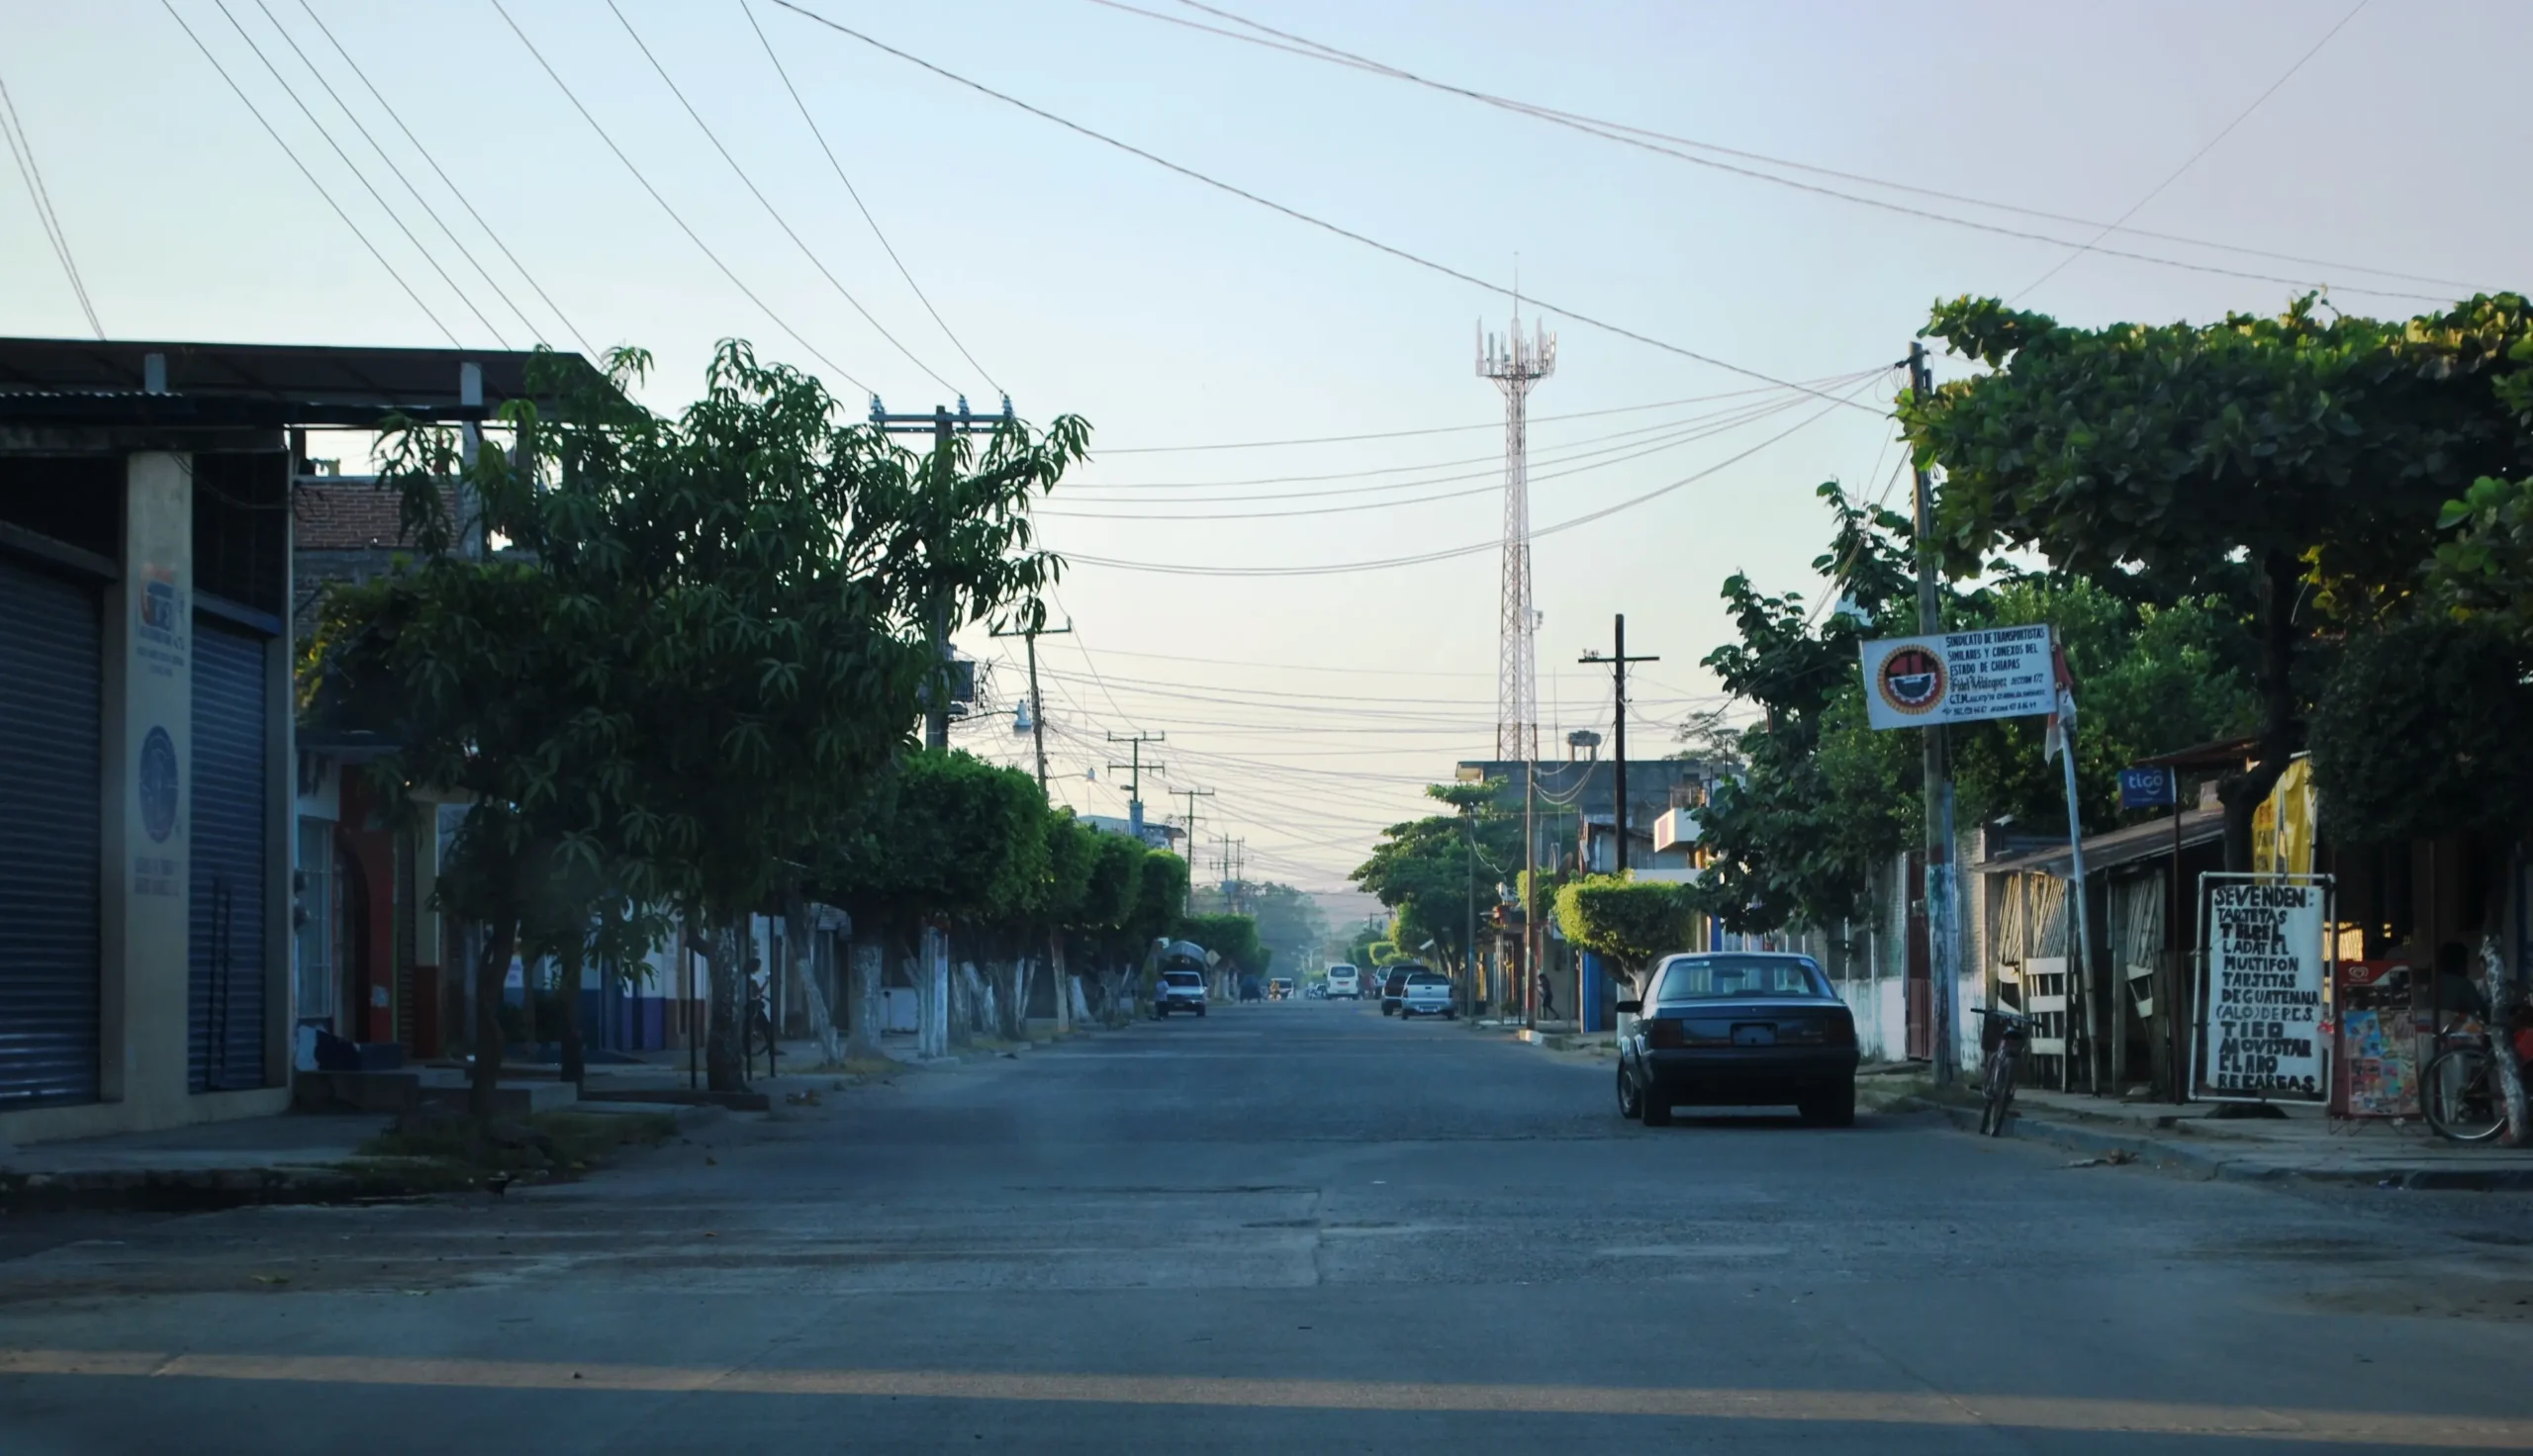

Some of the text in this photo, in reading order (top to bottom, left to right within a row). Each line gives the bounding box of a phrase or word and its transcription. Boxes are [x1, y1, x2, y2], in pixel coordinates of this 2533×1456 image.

[1945, 627, 2045, 648] SINDICATO DE TRANSPORTISTAS
[1947, 643, 2038, 662] SIMILARES Y CONEXOS DEL
[1949, 658, 2020, 678] ESTADO DE CHIAPAS
[2216, 908, 2288, 924] TARJETAS
[2222, 941, 2290, 955] LADATEL
[2223, 956, 2299, 971] MULTIFON
[2222, 971, 2297, 988] TARJETAS
[2218, 1037, 2312, 1057] MOVISTAR
[2218, 1054, 2279, 1073] CLARO
